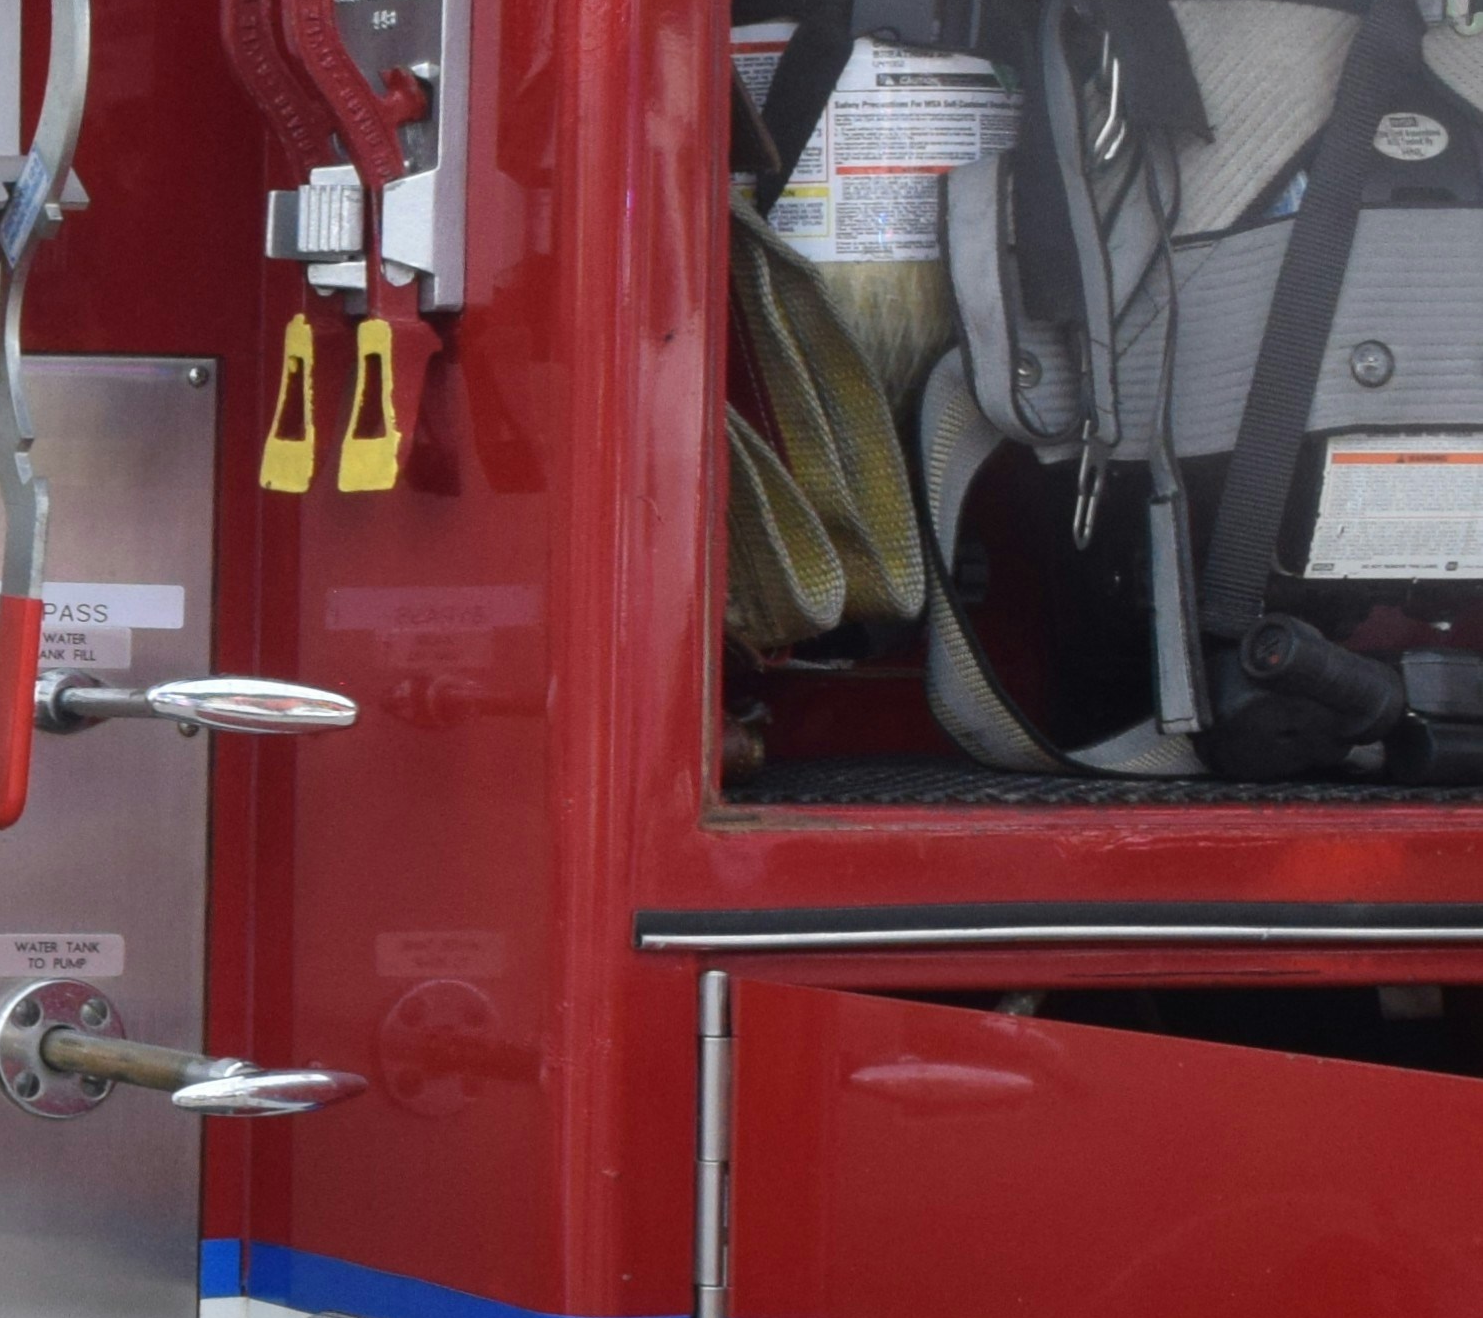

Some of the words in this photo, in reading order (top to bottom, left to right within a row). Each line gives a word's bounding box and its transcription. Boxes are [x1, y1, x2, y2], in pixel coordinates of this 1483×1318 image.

[43, 633, 87, 645] WATER
[73, 649, 96, 662] FILL
[15, 942, 58, 953] WATER
[66, 942, 99, 953] TANK
[28, 958, 46, 969] TO
[53, 958, 87, 970] PUMP
